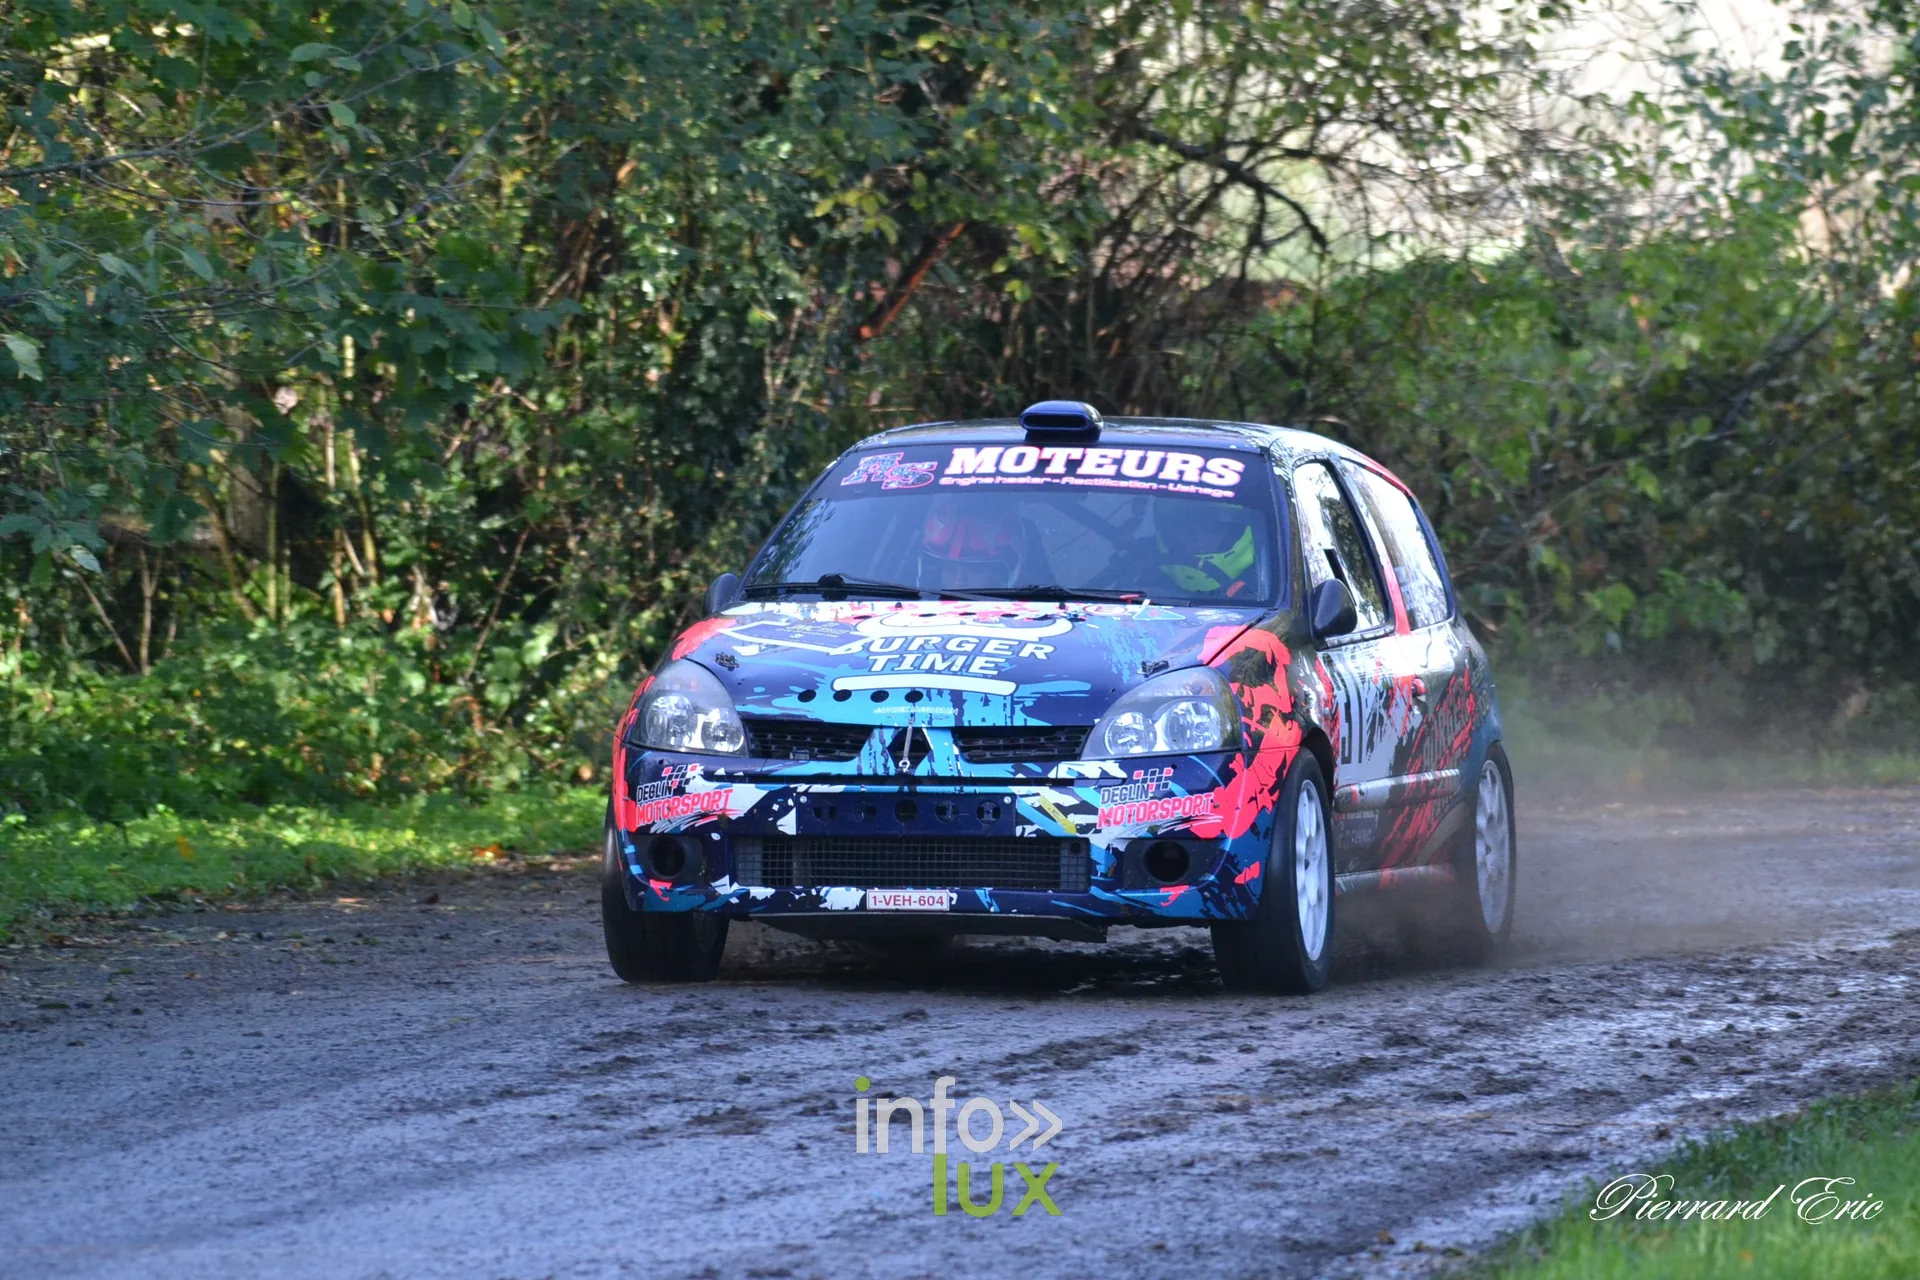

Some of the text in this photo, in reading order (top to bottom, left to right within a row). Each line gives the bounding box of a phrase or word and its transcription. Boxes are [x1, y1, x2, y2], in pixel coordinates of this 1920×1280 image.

[944, 446, 1245, 487] MOTEURS
[868, 653, 1006, 676] TIME
[636, 781, 673, 801] DEGLIN
[1101, 783, 1150, 804] DEGLIN
[636, 789, 733, 826] MOTORSPORT
[1097, 792, 1214, 829] MOTORSPORT
[872, 895, 944, 906] 1-VEH-604
